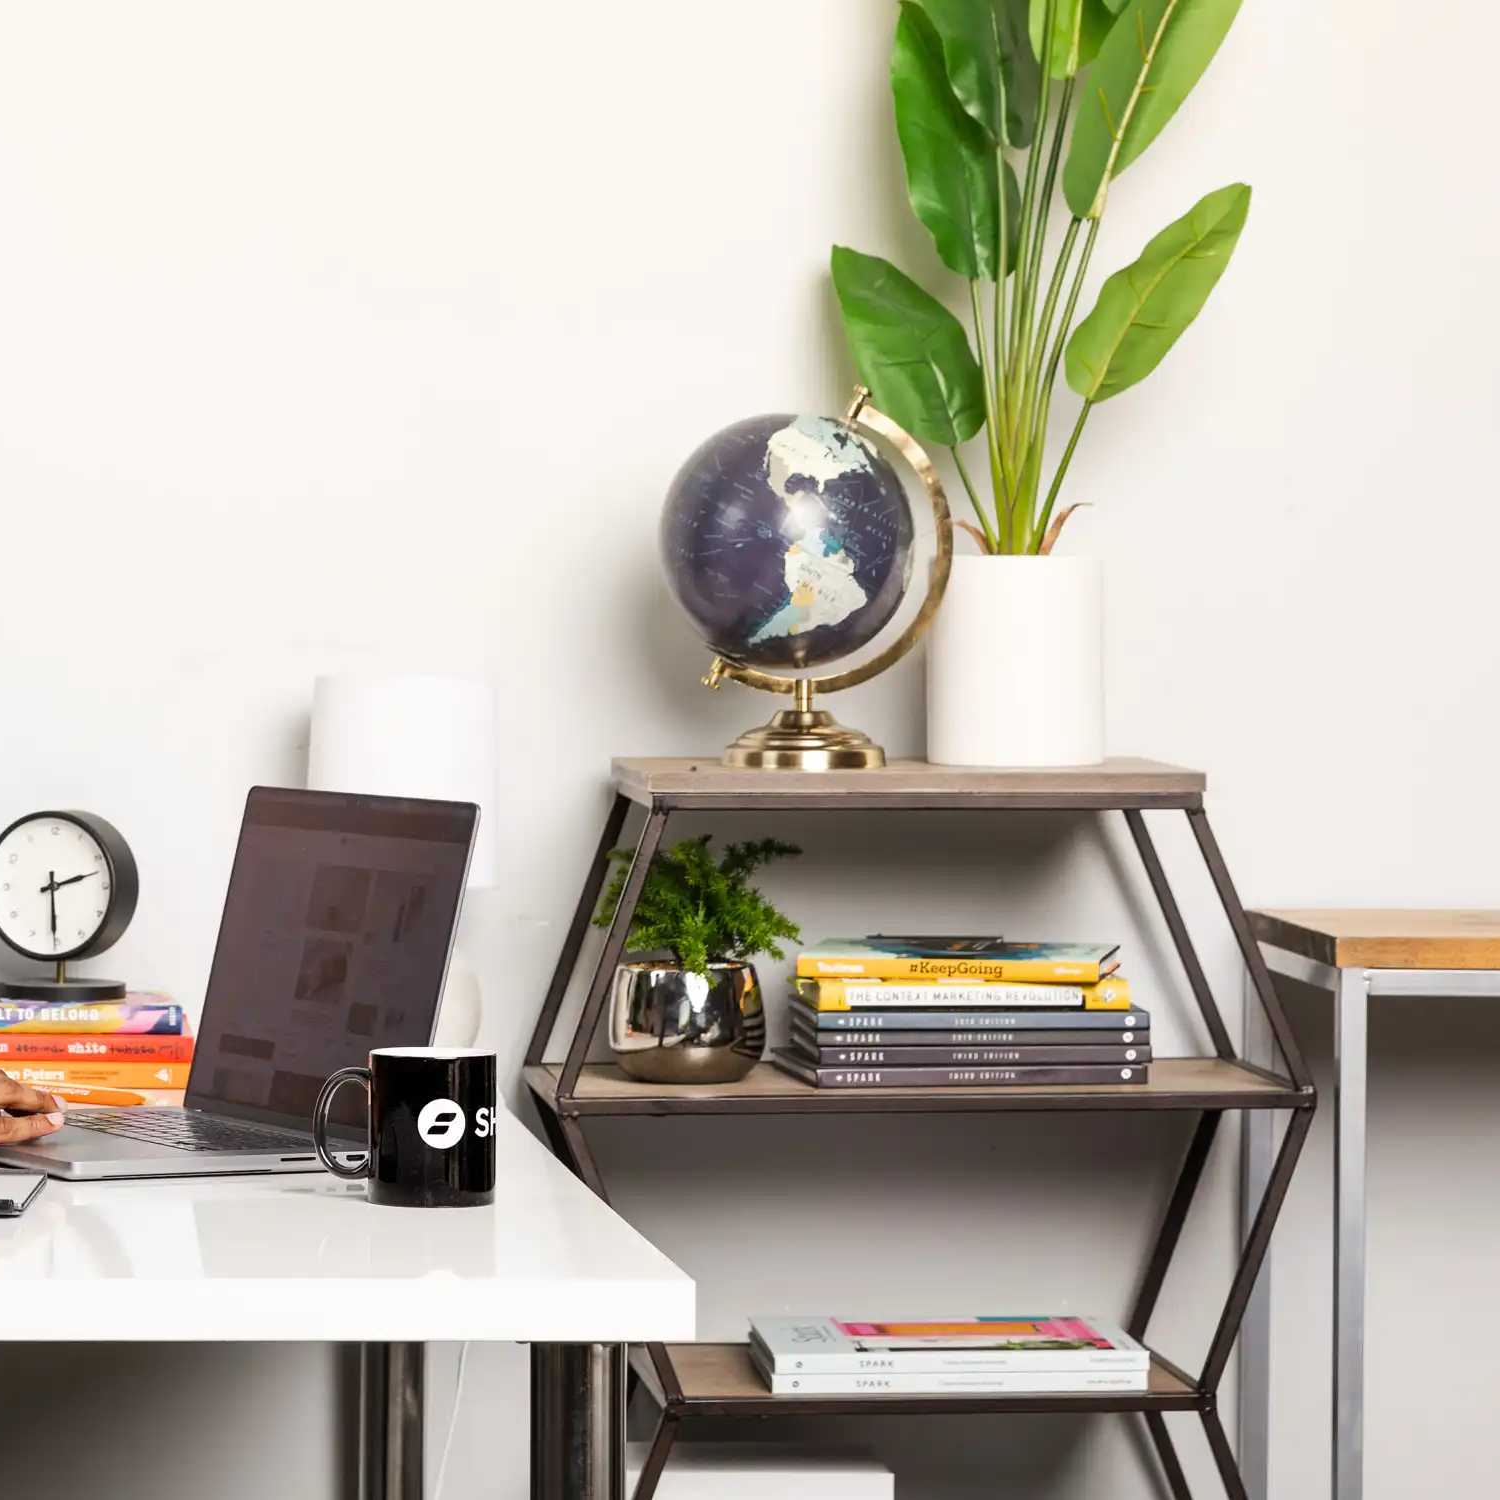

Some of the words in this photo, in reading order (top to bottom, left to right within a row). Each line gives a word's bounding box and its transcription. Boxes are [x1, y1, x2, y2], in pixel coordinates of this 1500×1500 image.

[910, 962, 1003, 978] #KeepGoing
[850, 991, 872, 1002] THE
[876, 991, 928, 1002] CONTEXT
[933, 991, 1000, 1002] MARKETING
[1005, 990, 1079, 1002] REVOLUTION
[17, 1008, 34, 1021] TO
[40, 1008, 100, 1021] BELONG
[849, 1017, 883, 1026] SPARK
[846, 1033, 880, 1043] SPARK
[67, 1042, 108, 1054] white
[850, 1052, 884, 1061] SPARK
[23, 1067, 65, 1081] Peters
[846, 1072, 881, 1082] SPARK
[859, 1360, 894, 1368] SPARK
[856, 1380, 891, 1388] SPARK
